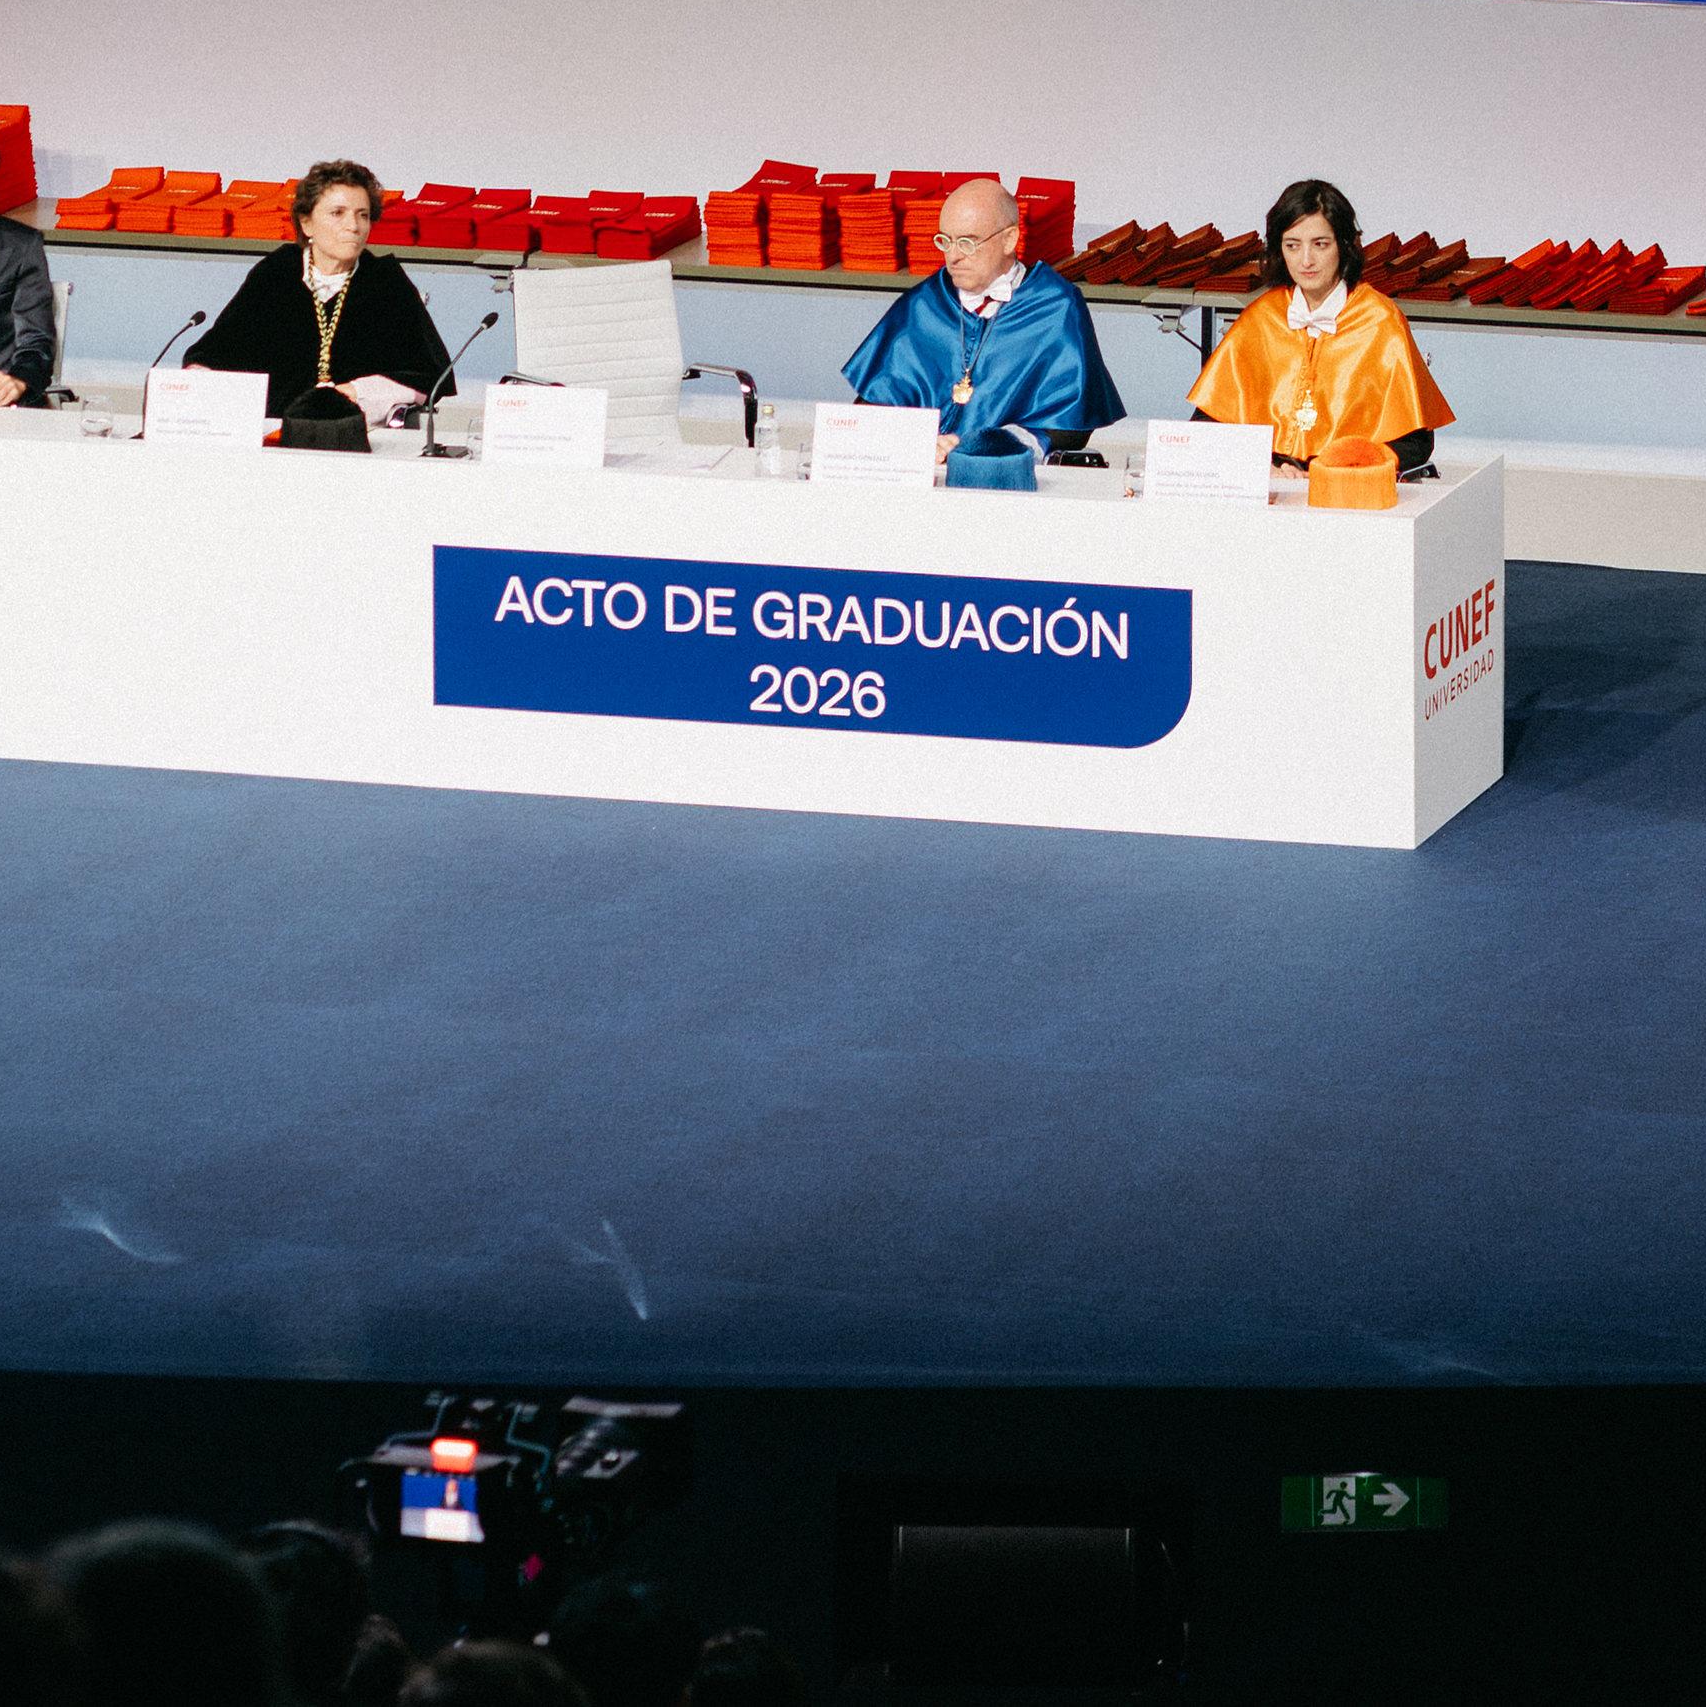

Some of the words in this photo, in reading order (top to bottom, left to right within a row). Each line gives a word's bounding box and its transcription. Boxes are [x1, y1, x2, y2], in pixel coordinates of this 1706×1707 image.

[494, 575, 647, 630] ACTO
[664, 585, 737, 636] DE
[752, 592, 1128, 660] GRADUACIÓN
[1424, 579, 1495, 680] CUNEF
[749, 664, 887, 720] 2026
[1424, 648, 1494, 721] UNIVERSIDAD
